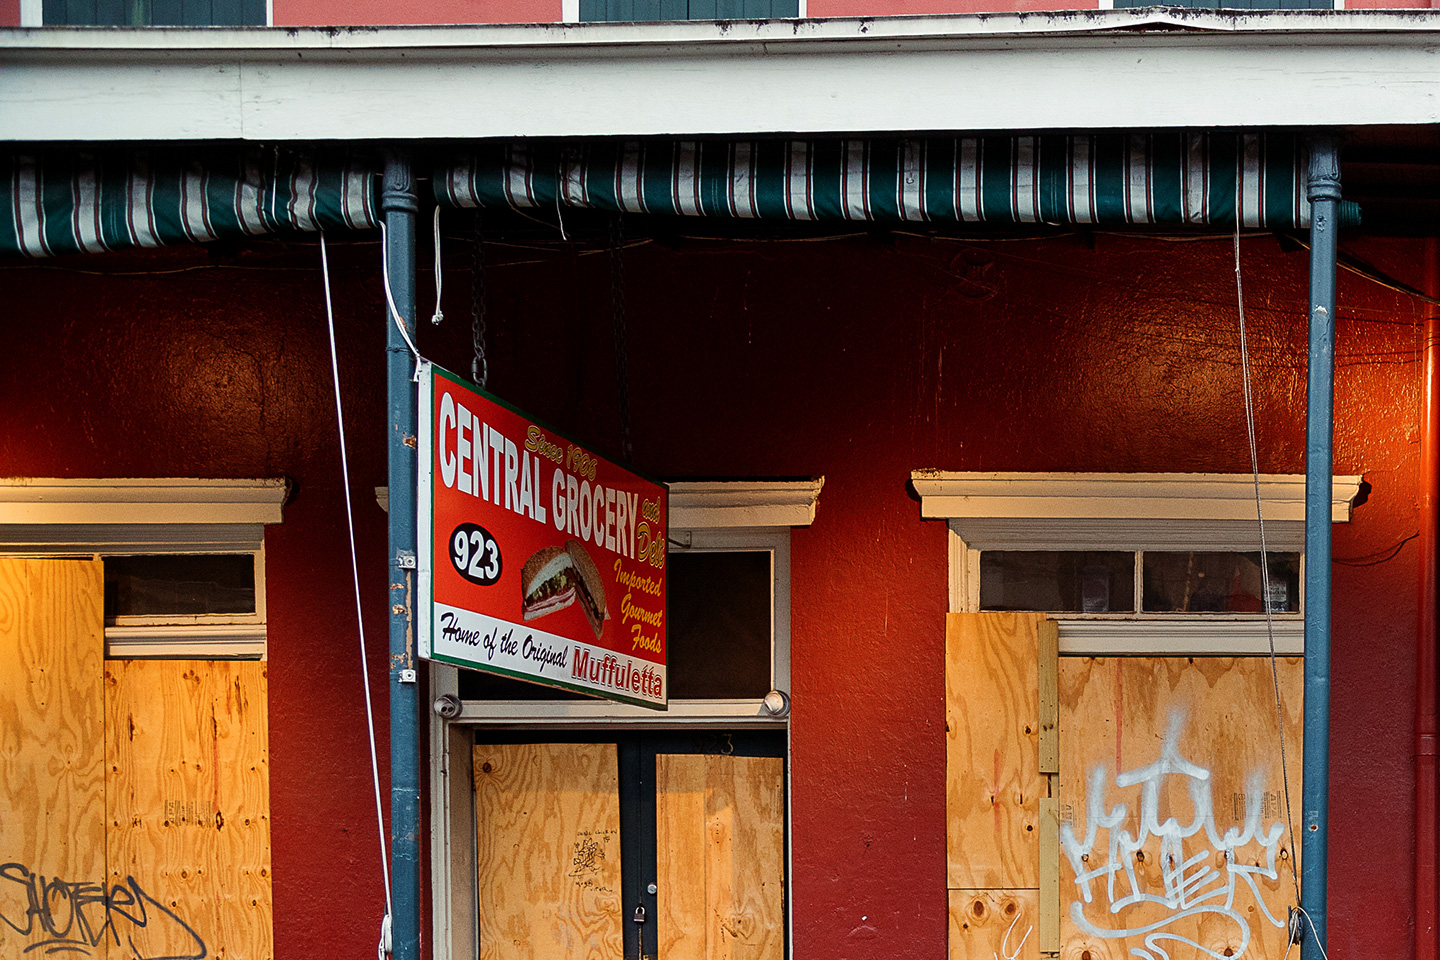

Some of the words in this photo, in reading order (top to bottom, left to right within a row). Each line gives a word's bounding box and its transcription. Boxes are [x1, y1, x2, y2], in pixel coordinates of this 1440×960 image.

[439, 391, 547, 524] CENTRAL
[552, 468, 639, 560] GROCERY
[525, 425, 564, 464] Since
[566, 444, 598, 481] 1906
[642, 496, 661, 524] and
[454, 530, 499, 579] 923
[637, 521, 665, 569] Deli
[613, 558, 662, 597] Imported
[620, 593, 663, 628] Gourmet
[440, 612, 480, 646] Home
[483, 627, 497, 661] of
[500, 628, 518, 656] the
[522, 635, 569, 672] Original
[571, 645, 664, 699] Muffuletta
[631, 624, 662, 654] Foods
